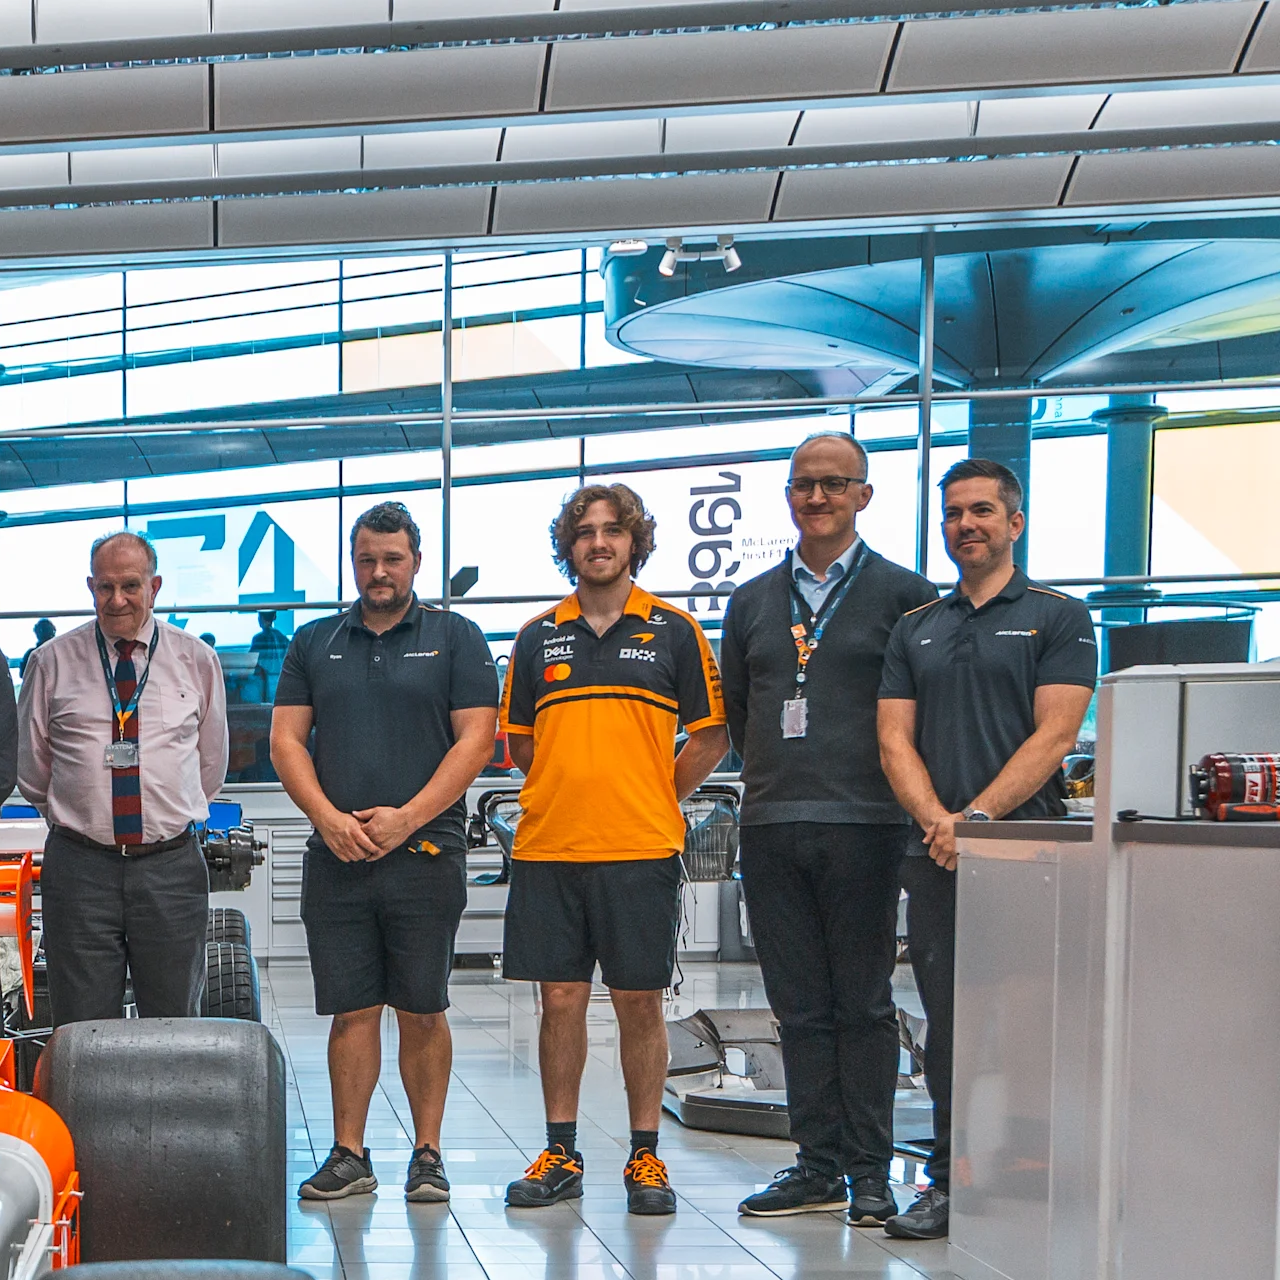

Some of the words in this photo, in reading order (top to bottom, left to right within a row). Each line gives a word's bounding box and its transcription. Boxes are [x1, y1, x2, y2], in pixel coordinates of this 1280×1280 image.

[543, 636, 566, 646] Android
[544, 645, 574, 659] DELL
[619, 648, 656, 662] OKX
